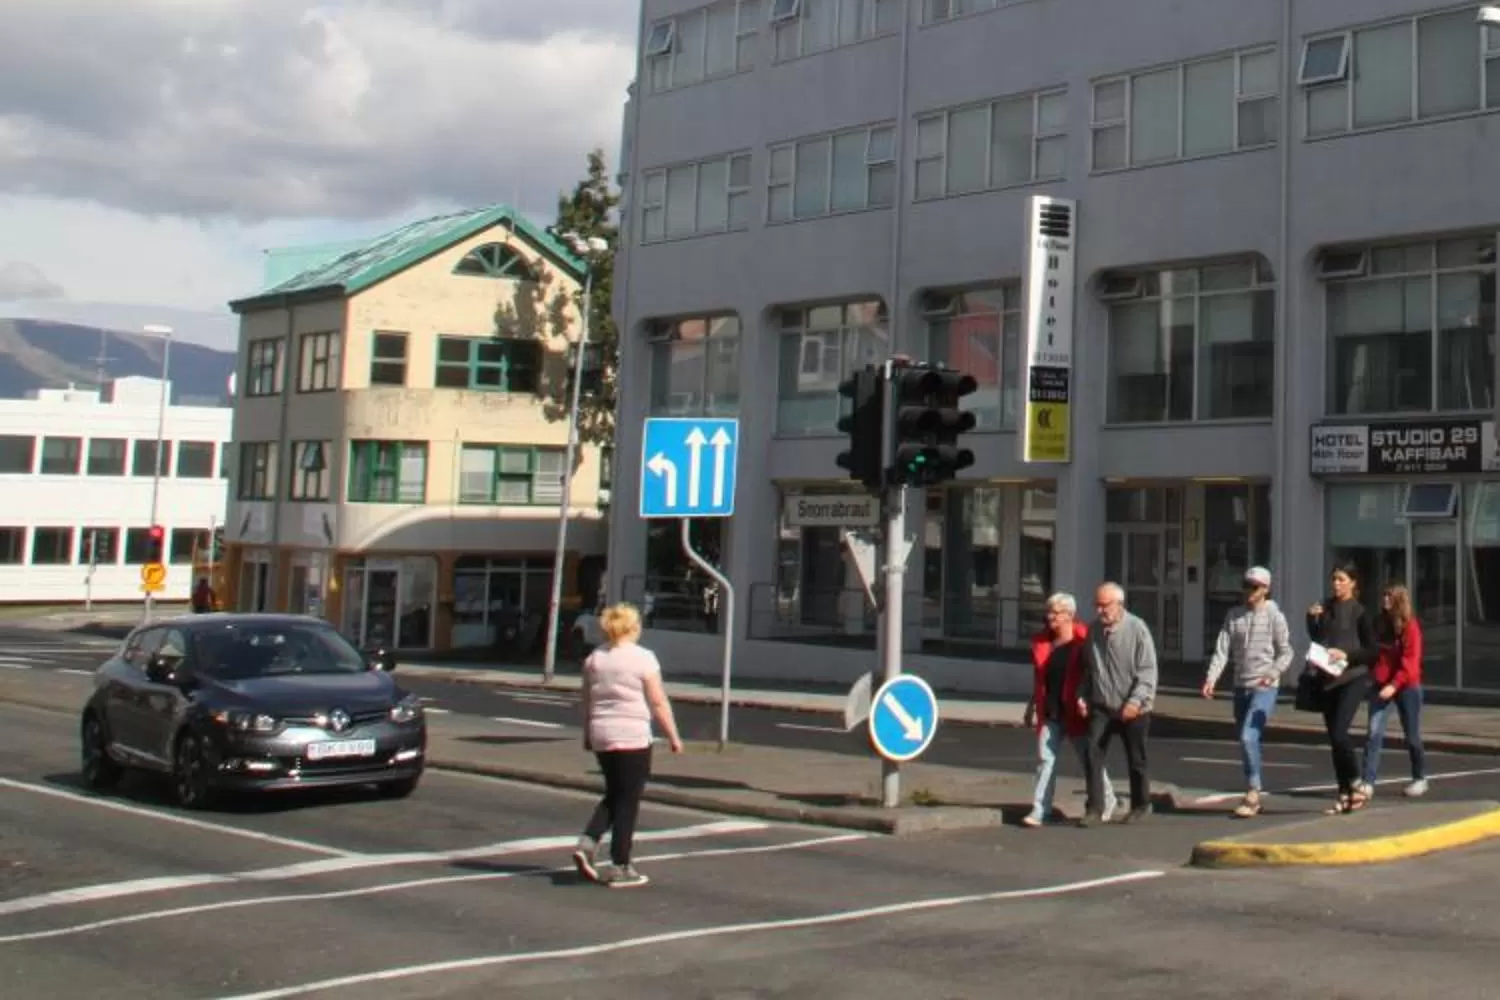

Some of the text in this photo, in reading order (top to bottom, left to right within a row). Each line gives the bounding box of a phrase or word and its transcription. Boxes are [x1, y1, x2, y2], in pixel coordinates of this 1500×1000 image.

[1315, 433, 1364, 448] HOTEL
[1371, 426, 1478, 447] STUDIO 29
